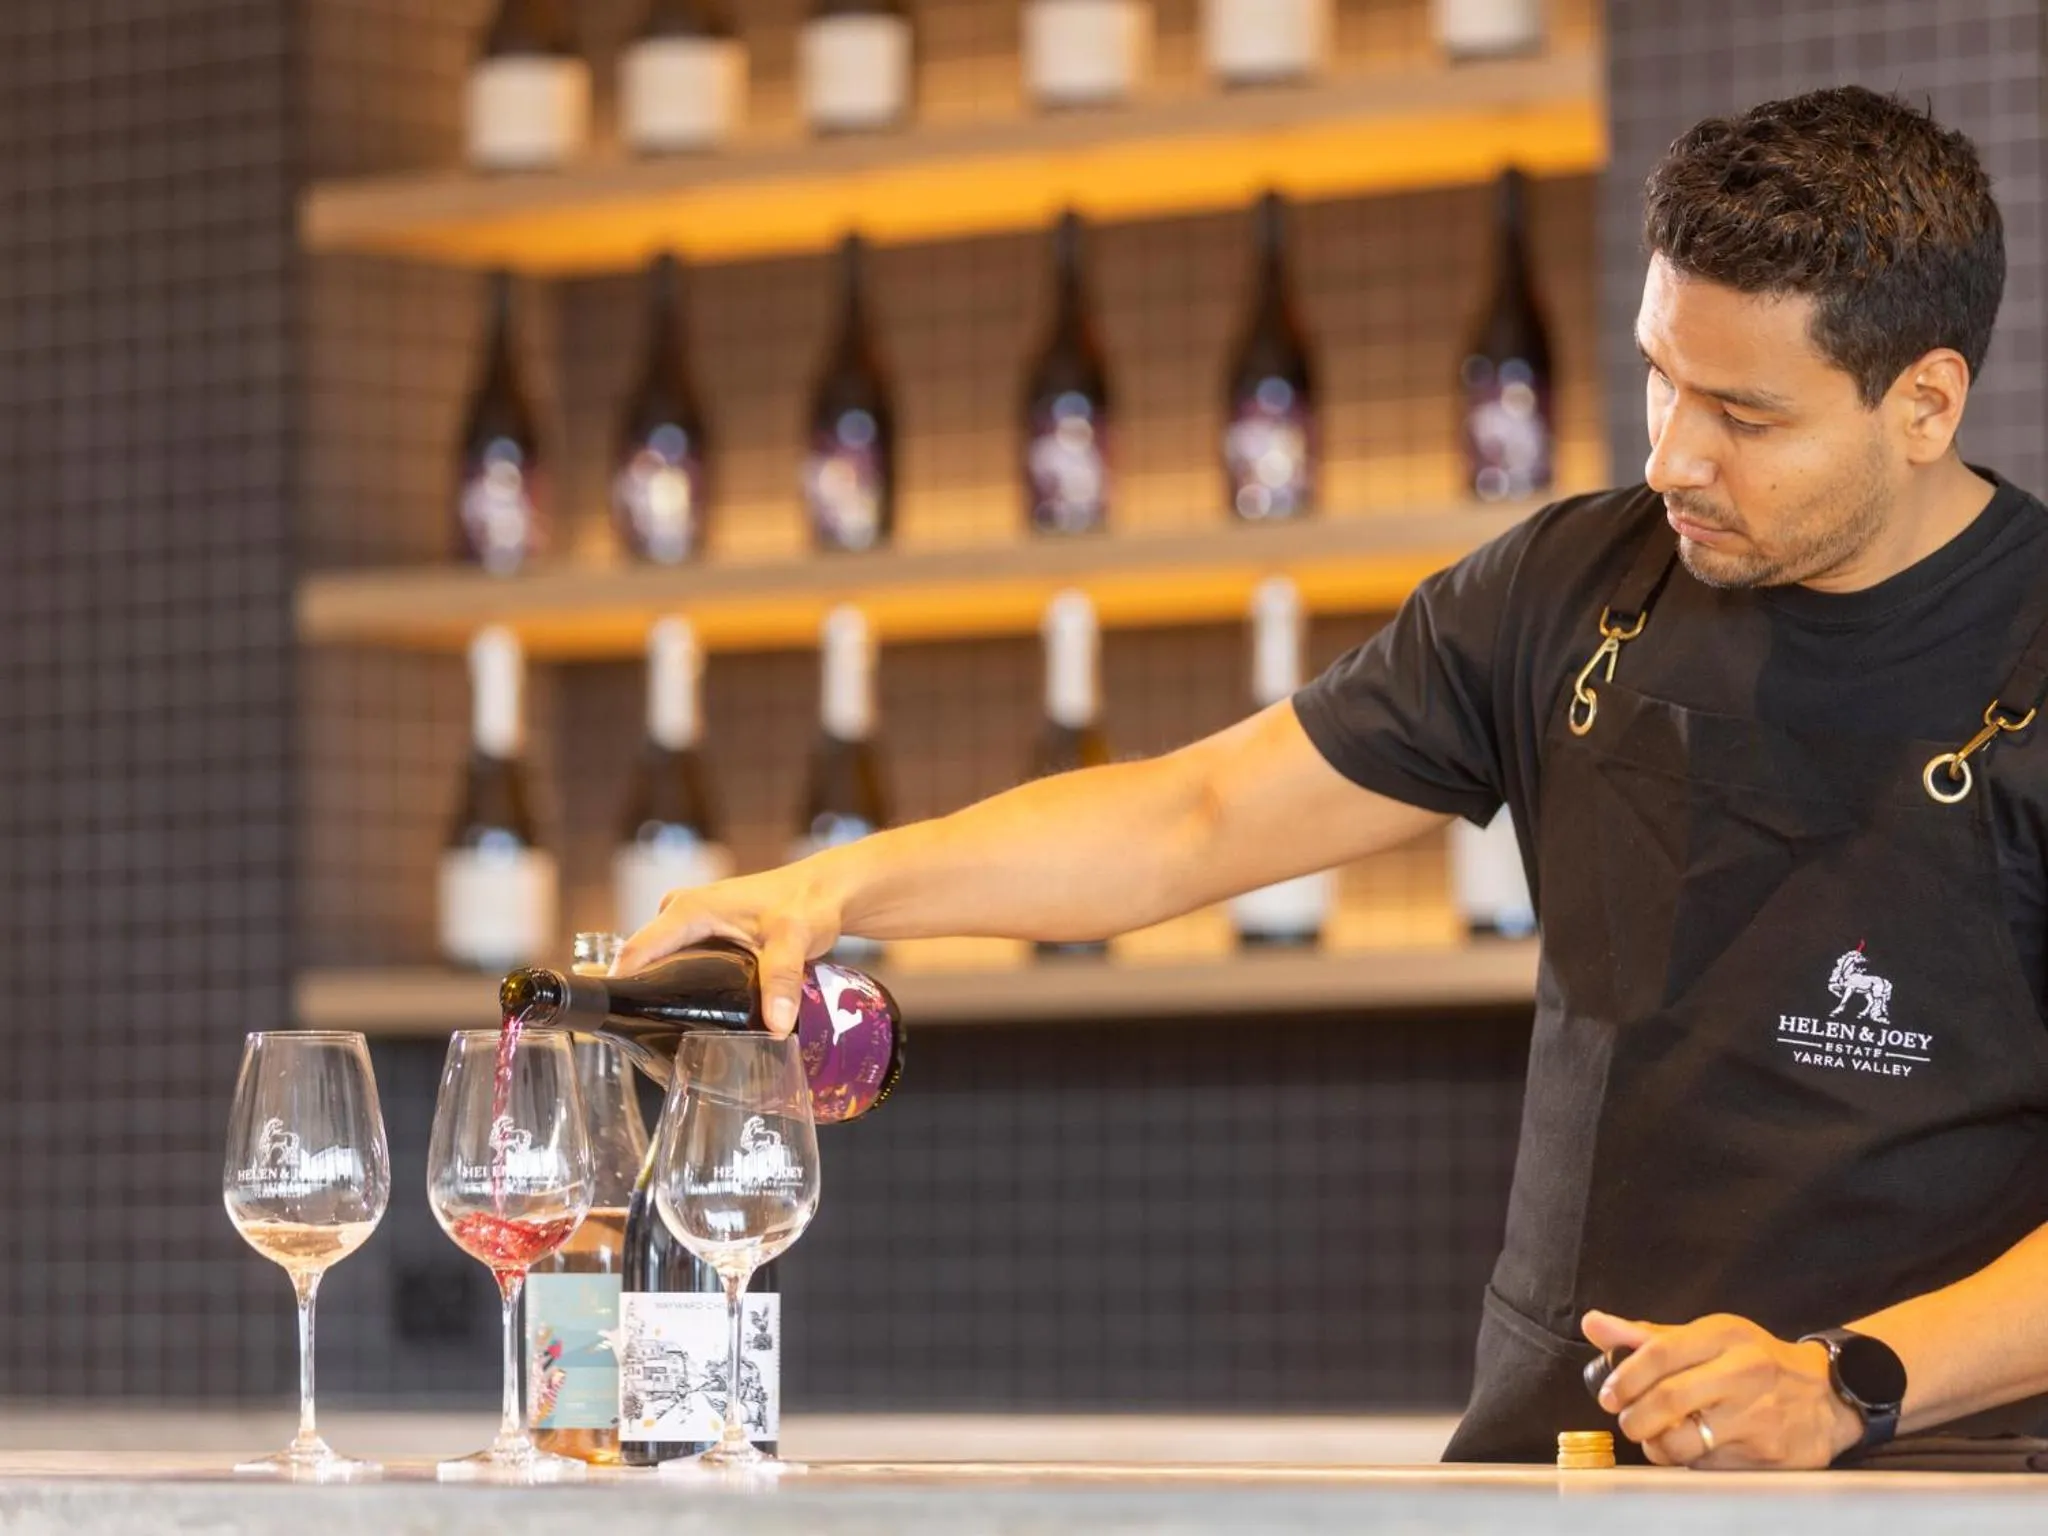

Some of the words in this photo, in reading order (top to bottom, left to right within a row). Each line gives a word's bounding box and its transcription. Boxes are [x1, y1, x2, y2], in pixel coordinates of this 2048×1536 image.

[1778, 1015, 1856, 1040] HELEN
[1859, 1026, 1875, 1043] &
[1877, 1029, 1932, 1050] JOEY
[1825, 1042, 1882, 1058] ESTATE
[1793, 1050, 1845, 1068] YARRA
[1852, 1058, 1912, 1077] VALLEY
[238, 1167, 278, 1181] HELEN
[280, 1167, 290, 1179] &
